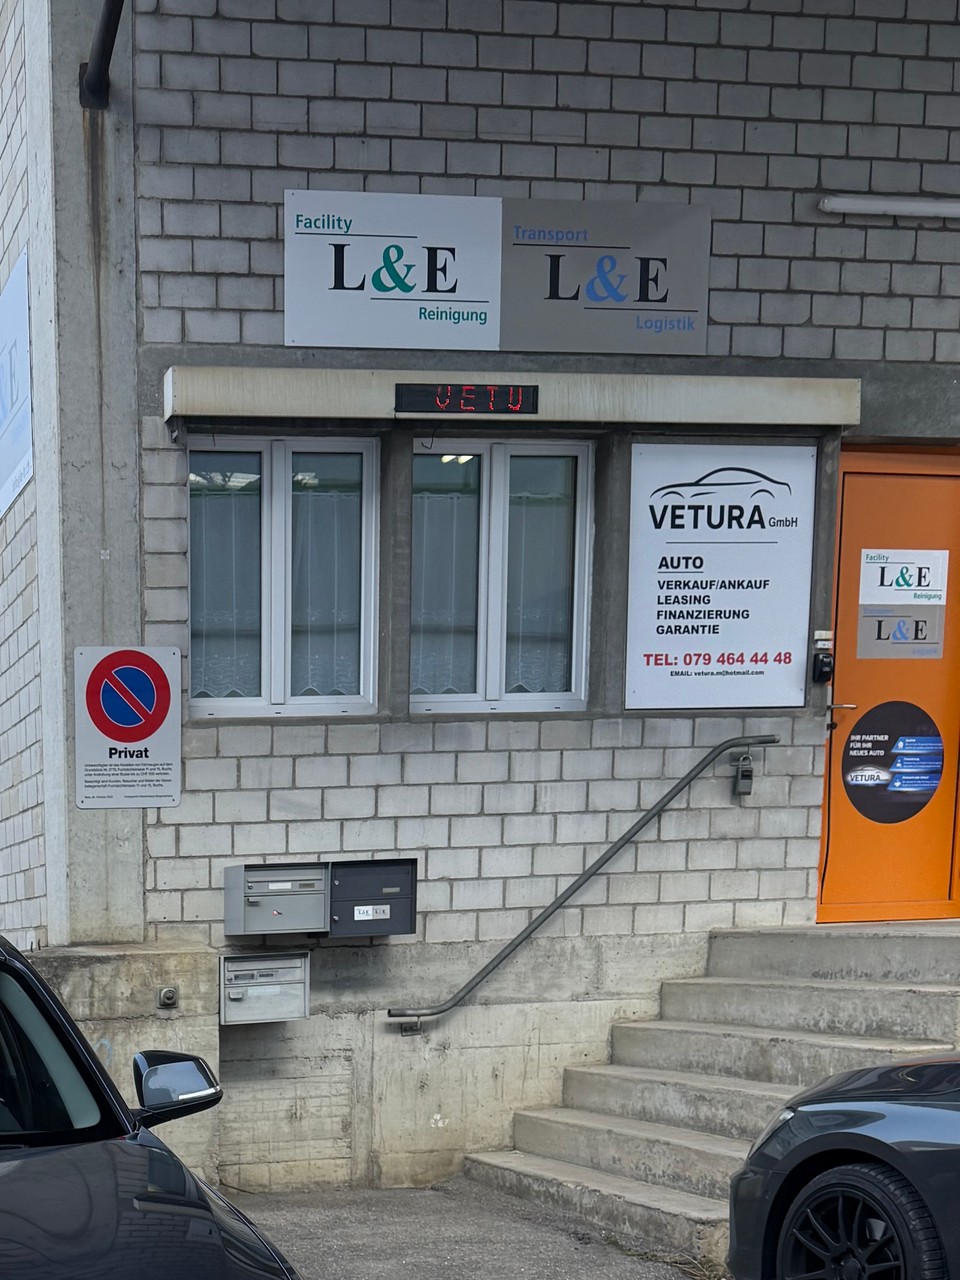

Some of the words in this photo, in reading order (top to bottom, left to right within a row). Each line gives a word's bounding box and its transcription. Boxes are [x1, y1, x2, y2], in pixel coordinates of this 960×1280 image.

[295, 213, 353, 234] Facility
[513, 225, 589, 243] Transport
[328, 243, 458, 294] L&E
[544, 253, 669, 304] L&E
[418, 306, 488, 326] Reinigung
[635, 315, 695, 332] Logistik
[649, 504, 766, 530] VETURA
[768, 516, 798, 528] GmbH
[658, 556, 704, 570] AUTO
[865, 553, 889, 562] Facility
[878, 566, 931, 587] L&E
[657, 579, 770, 590] VERKAUF/ANKAUF
[657, 595, 711, 605] LEASING
[913, 592, 942, 600] Reinigung
[656, 610, 750, 620] FINANZIERUNG
[656, 624, 720, 635] GARANTIE
[875, 619, 928, 640] L&E
[643, 653, 678, 666] TEL:
[683, 653, 712, 666] 079
[716, 652, 745, 665] 464
[750, 652, 769, 665] 44
[773, 652, 792, 664] 48
[108, 747, 149, 759] Privat
[849, 774, 881, 782] VETURA
